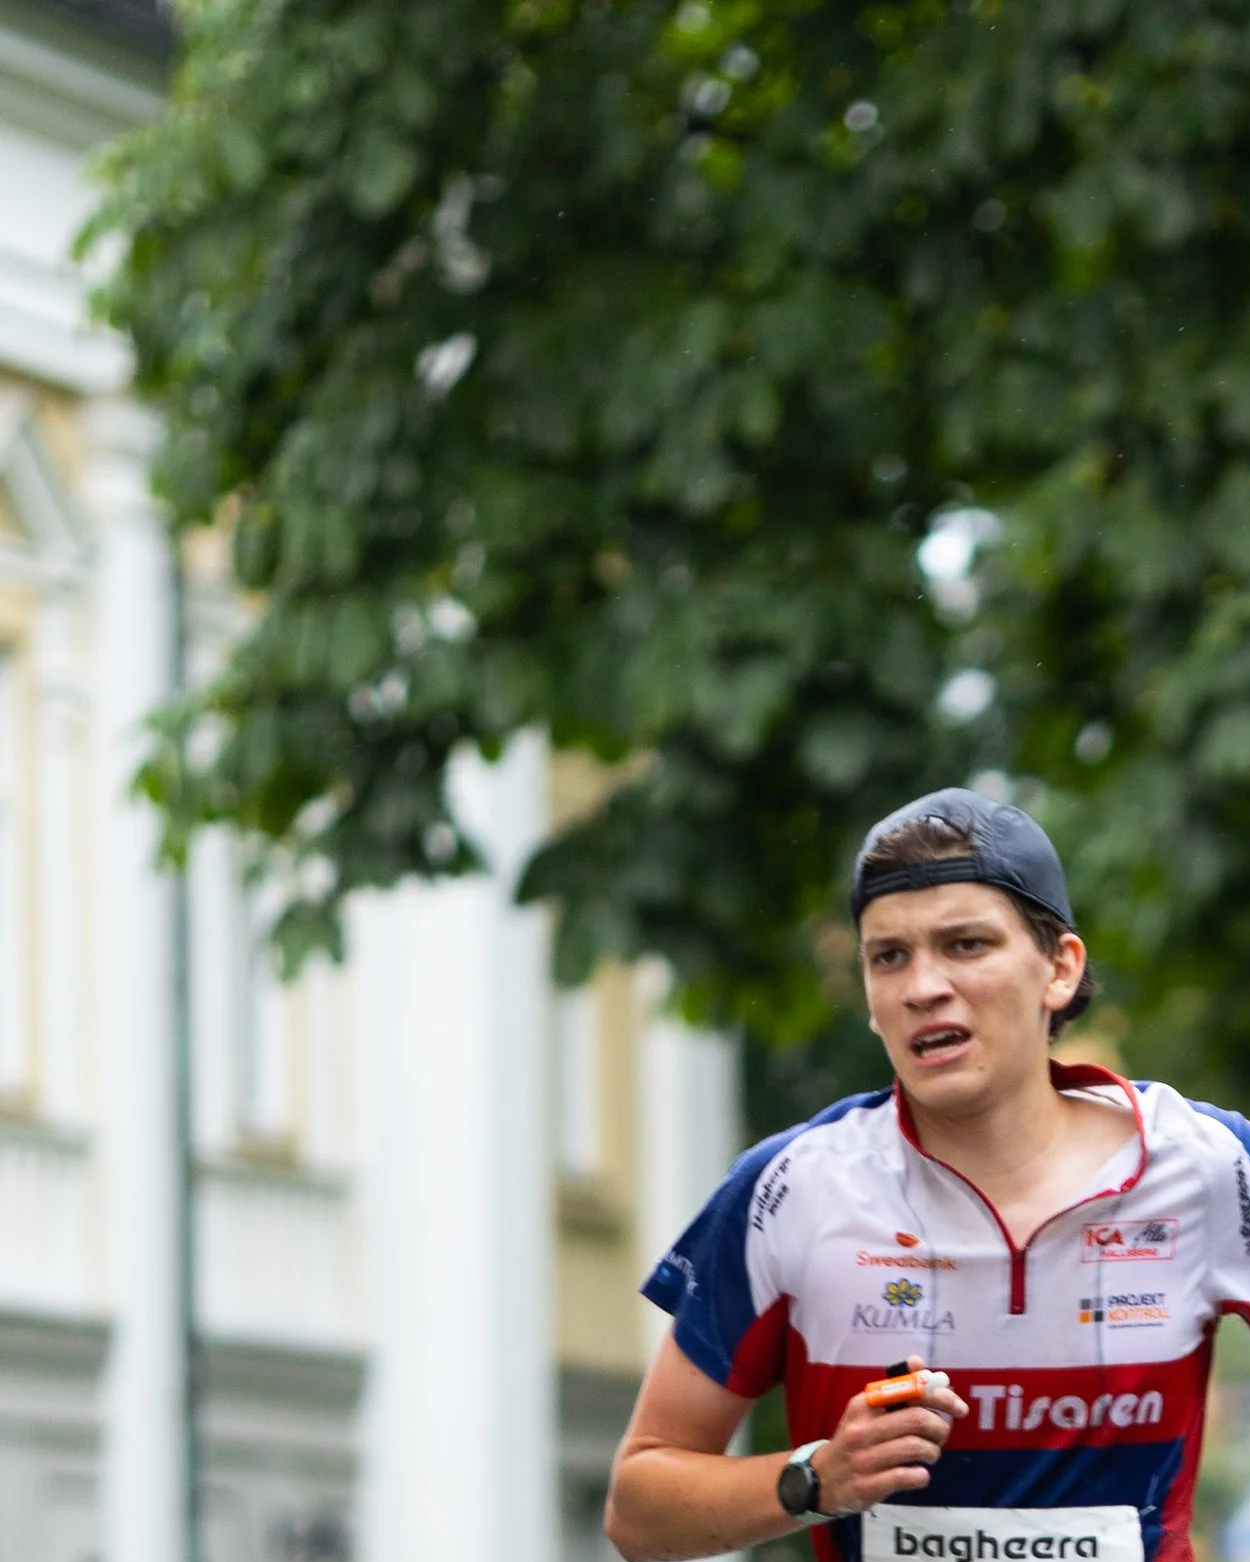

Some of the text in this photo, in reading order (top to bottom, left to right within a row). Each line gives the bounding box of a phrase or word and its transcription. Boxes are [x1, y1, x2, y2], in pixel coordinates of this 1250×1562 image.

[1085, 1228, 1124, 1246] ICA
[856, 1250, 957, 1270] Swedbank
[850, 1304, 956, 1330] KUMLA
[969, 1384, 1164, 1431] Tisaren
